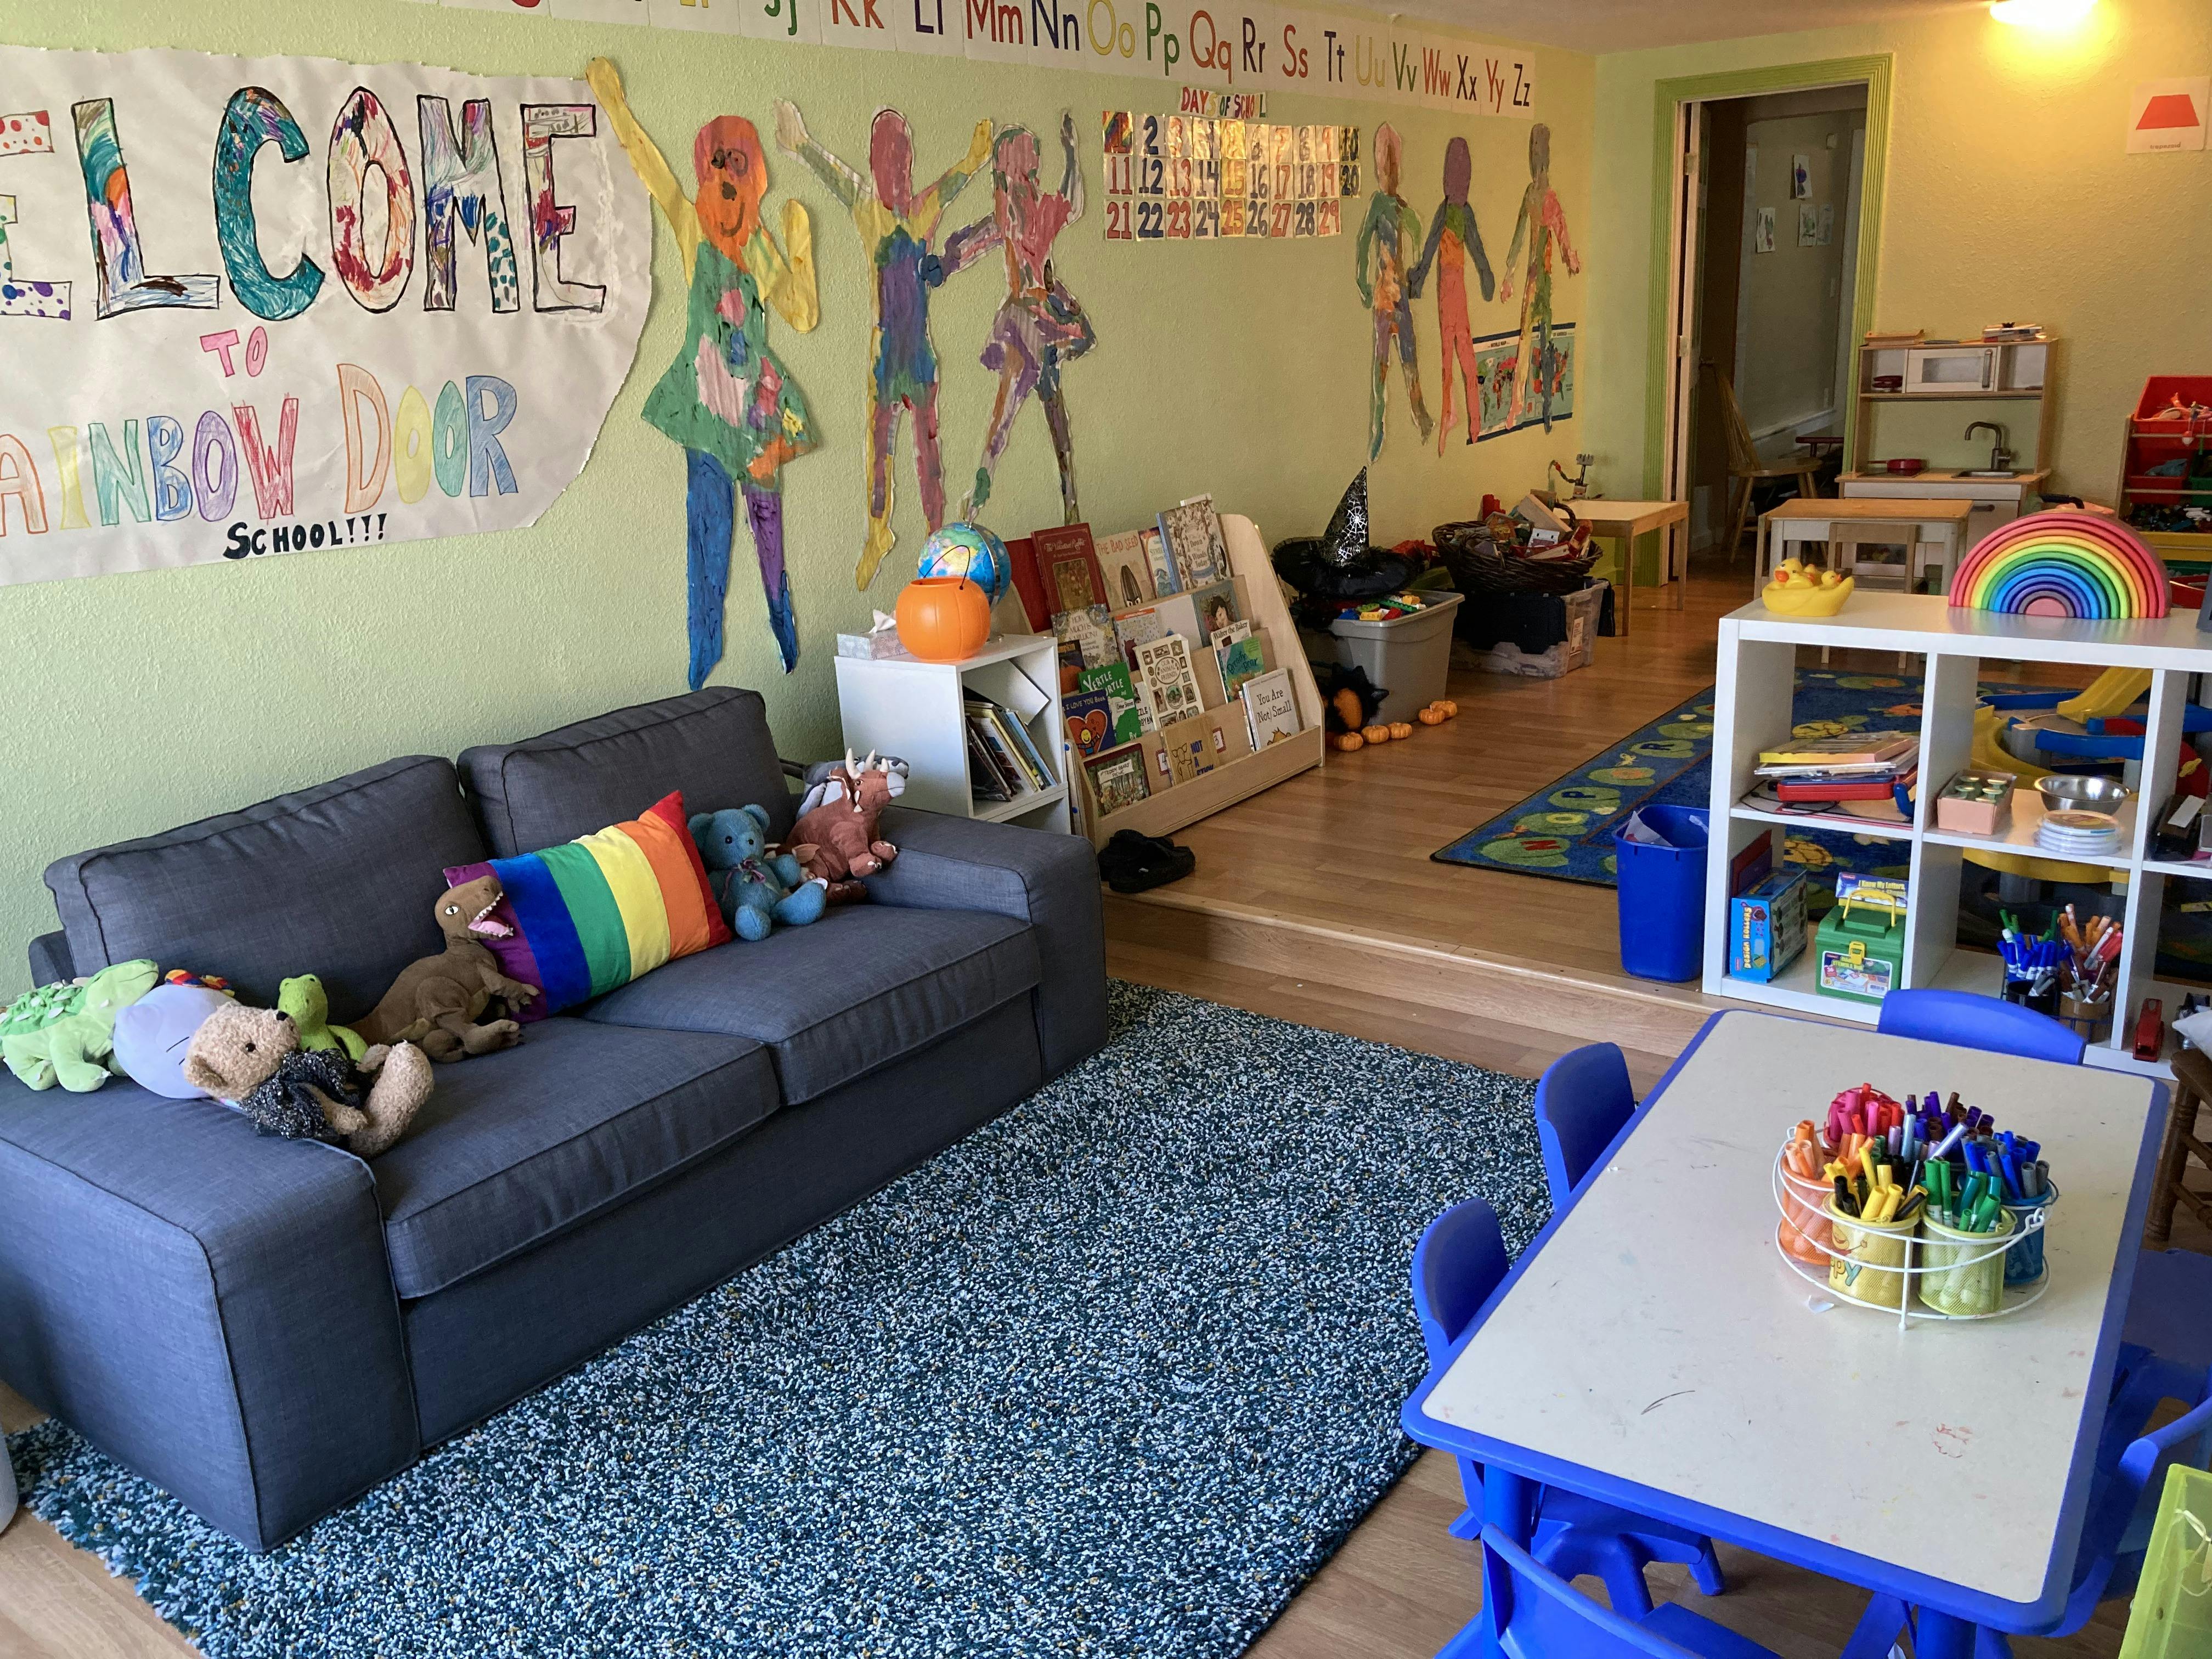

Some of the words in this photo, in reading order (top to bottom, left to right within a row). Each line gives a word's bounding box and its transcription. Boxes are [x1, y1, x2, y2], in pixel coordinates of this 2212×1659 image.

[764, 0, 797, 36] j
[966, 0, 1024, 44] Mm
[1031, 0, 1080, 51] Nn
[1087, 0, 1136, 58] Oo
[1146, 2, 1180, 76] Pp
[1189, 10, 1232, 84] Qq
[1242, 17, 1266, 72] Rr
[1282, 24, 1308, 78] Ss
[1324, 30, 1345, 82] Tt
[1356, 35, 1386, 88] Uu
[1392, 42, 1418, 92] Vv
[1423, 47, 1451, 97] Ww
[1456, 54, 1477, 101] Xx
[1485, 58, 1505, 114] Yy
[1513, 63, 1531, 107] Zz
[1181, 87, 1216, 117] DAYS
[1219, 95, 1231, 116] OF
[1143, 116, 1159, 155] 2
[2150, 142, 2181, 150] trapezoid
[1109, 156, 1133, 195] 11
[1139, 159, 1164, 194] 12
[1170, 159, 1191, 197] 13
[1196, 160, 1218, 198] 14
[1224, 162, 1244, 195] 15
[1250, 165, 1267, 199] 16
[1275, 165, 1290, 200] 17
[1298, 164, 1316, 199] 18
[1321, 163, 1334, 198] 19
[1341, 164, 1359, 196] 20
[1107, 201, 1132, 239] 21
[1137, 202, 1164, 238] 22
[1167, 201, 1191, 238] 23
[1195, 201, 1220, 237] 24
[1222, 200, 1244, 235] 25
[1246, 200, 1267, 236] 26
[1271, 203, 1291, 237] 27
[1295, 201, 1314, 236] 28
[1319, 200, 1340, 234] 29
[200, 326, 268, 377] TO
[337, 363, 518, 515] DOOR
[223, 514, 387, 560] SCHOOL!!!
[1097, 543, 1109, 556] THE
[1110, 539, 1123, 553] BAD
[1125, 535, 1138, 551] SEED
[1214, 630, 1227, 640] Walter
[1235, 622, 1248, 631] Baker
[1083, 671, 1113, 692] YERTLE
[1161, 672, 1177, 680] FRIENDS
[1071, 701, 1082, 709] LOVE
[1256, 693, 1271, 705] You
[1272, 689, 1283, 701] Are
[1272, 700, 1292, 717] Small
[1190, 740, 1203, 754] NOT
[1214, 735, 1219, 746] 3
[1194, 757, 1199, 768] A
[1561, 791, 1596, 799] P
[1742, 907, 1752, 939] ROLLERS
[1742, 941, 1751, 969] DESIGN
